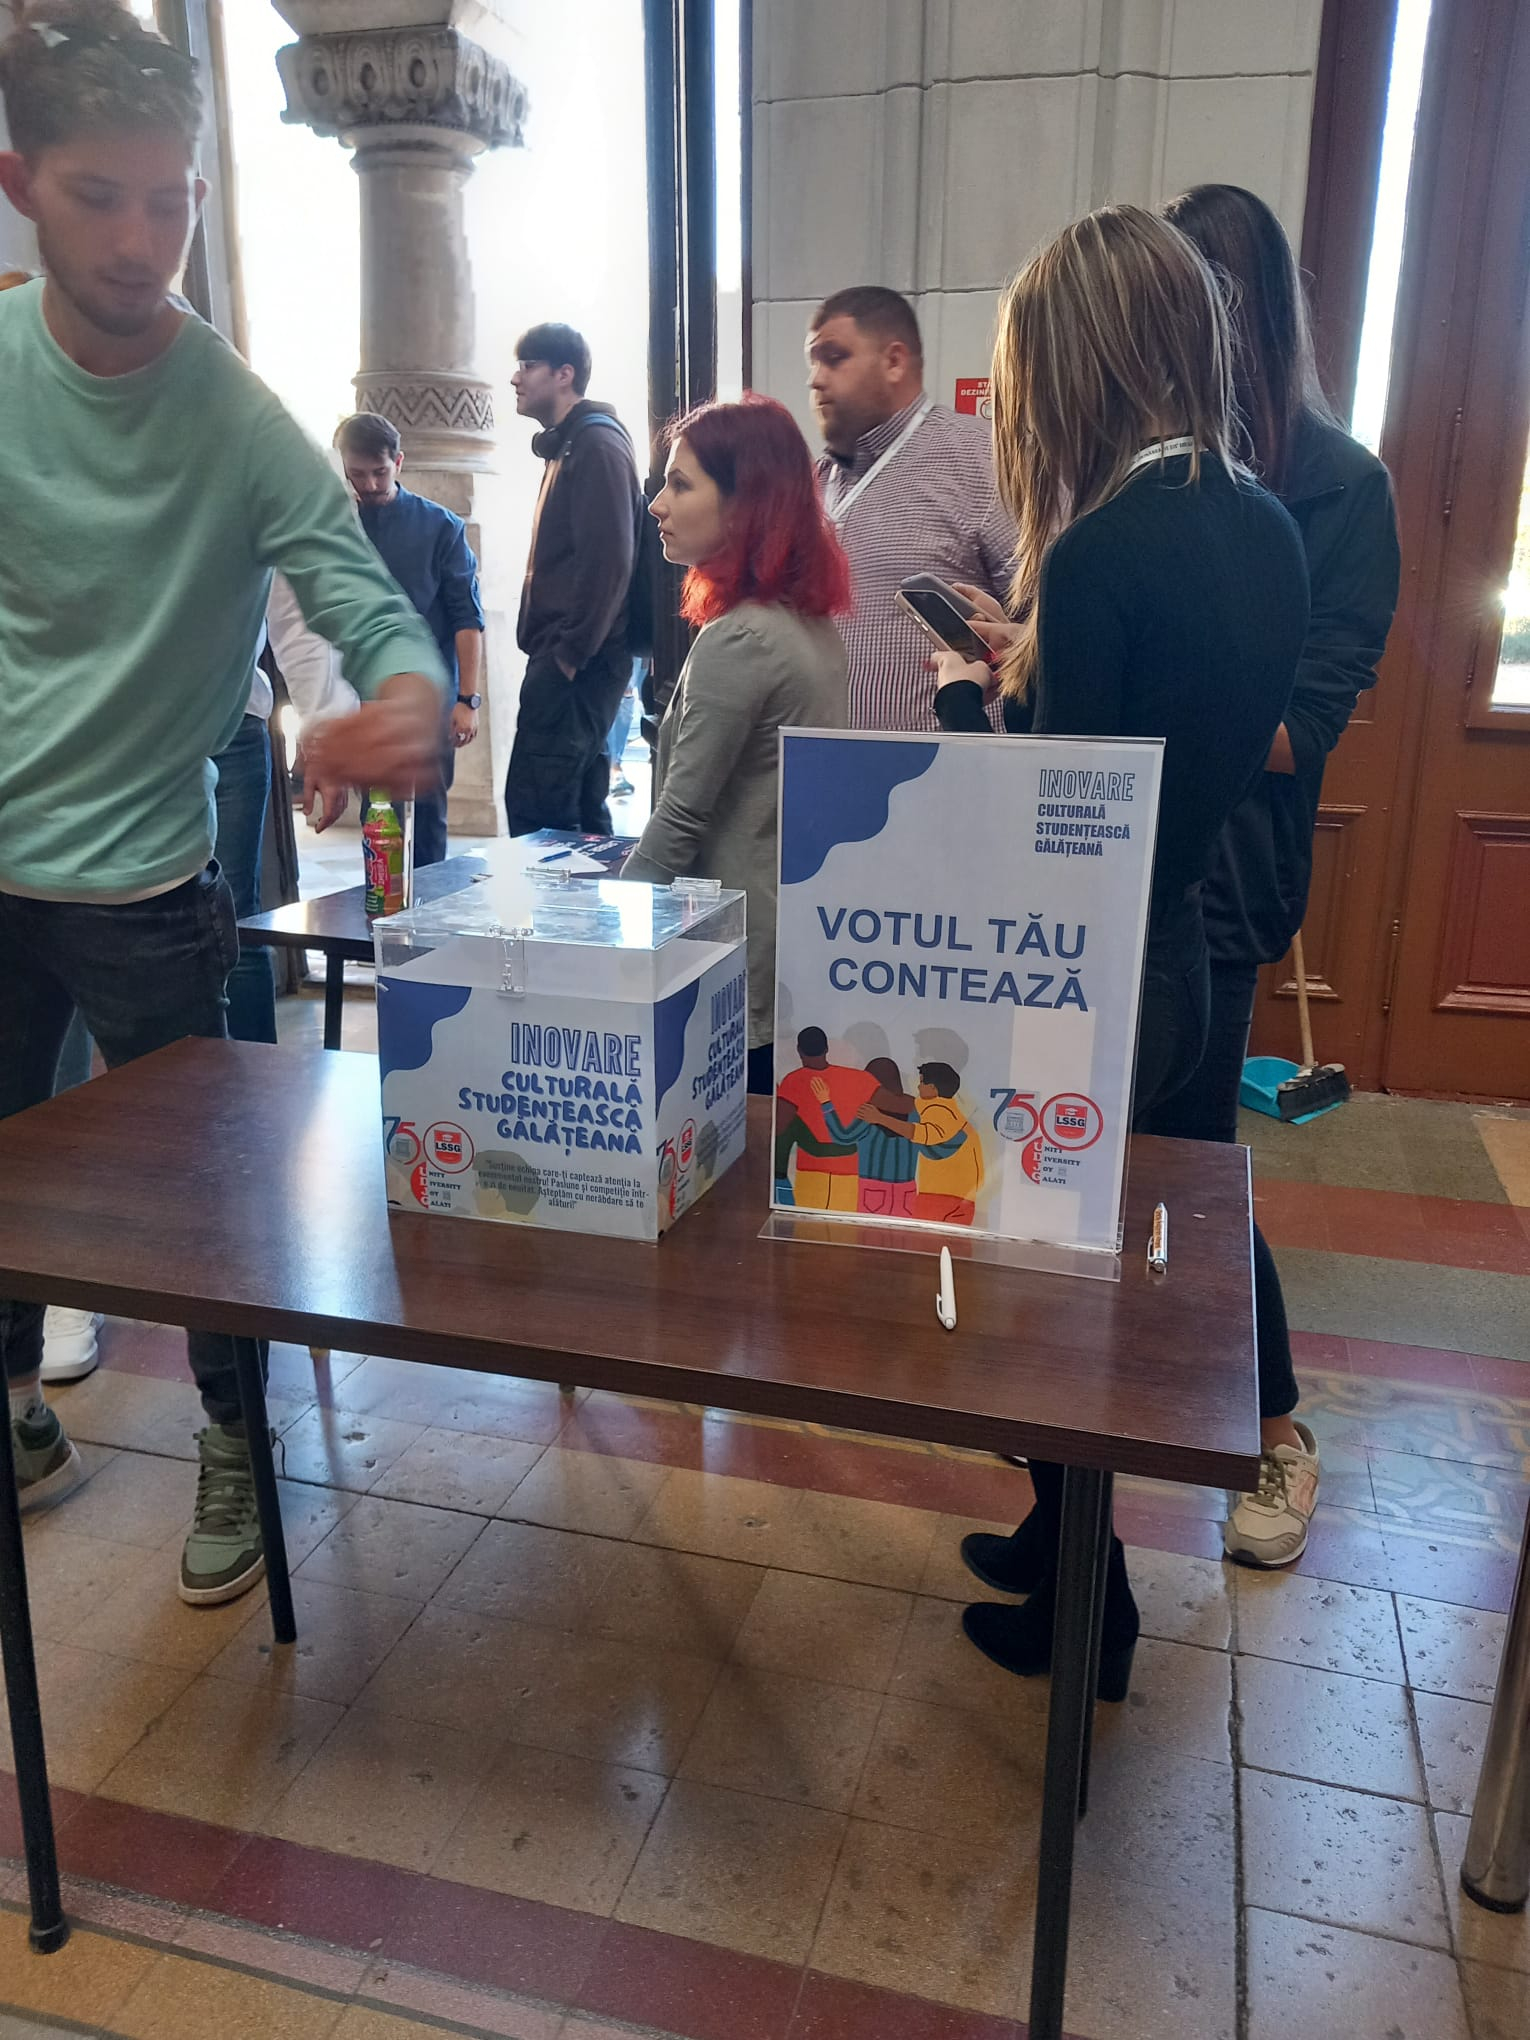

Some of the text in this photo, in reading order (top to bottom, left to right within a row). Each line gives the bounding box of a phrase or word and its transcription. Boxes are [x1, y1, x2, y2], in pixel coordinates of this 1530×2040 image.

[1039, 769, 1135, 801] INOVARE
[1037, 803, 1106, 820] CULTURALĂ
[1035, 822, 1130, 841] STUDENȚEASCĂ
[1034, 838, 1104, 858] GĂLĂȚEANĂ
[817, 906, 1086, 959] VOTUL TĂU
[829, 958, 1088, 1011] CONTEAZĂ
[511, 1023, 642, 1077] INOVARE
[501, 1071, 643, 1105] CULTURALĂ
[497, 1115, 643, 1156] GĂLĂȚEANĂ
[1056, 1116, 1086, 1128] LSSG
[435, 1142, 462, 1153] LSSG
